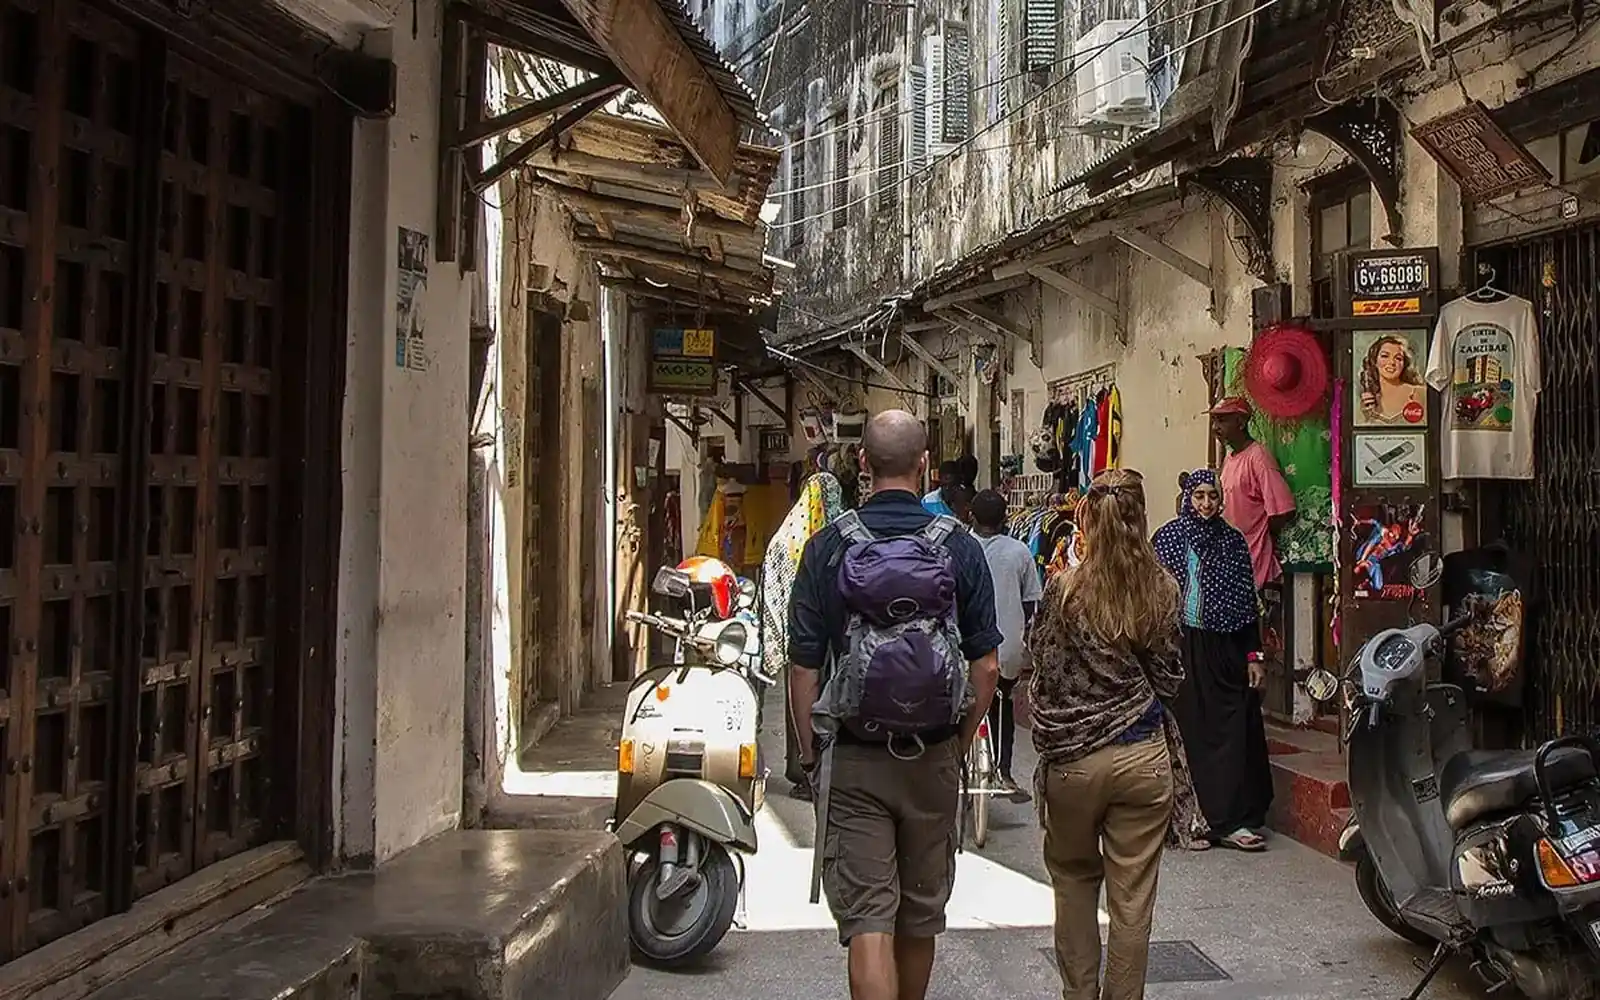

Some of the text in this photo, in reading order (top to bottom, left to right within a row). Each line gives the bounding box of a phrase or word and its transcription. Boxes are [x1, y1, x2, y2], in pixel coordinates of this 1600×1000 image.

[1428, 118, 1484, 148] ZANZIBAR
[1450, 136, 1487, 160] CURIO
[1466, 150, 1497, 173] SHOP
[1374, 284, 1409, 292] HAWAII
[1362, 301, 1407, 313] DHL
[1459, 343, 1508, 353] ZANZIBAR
